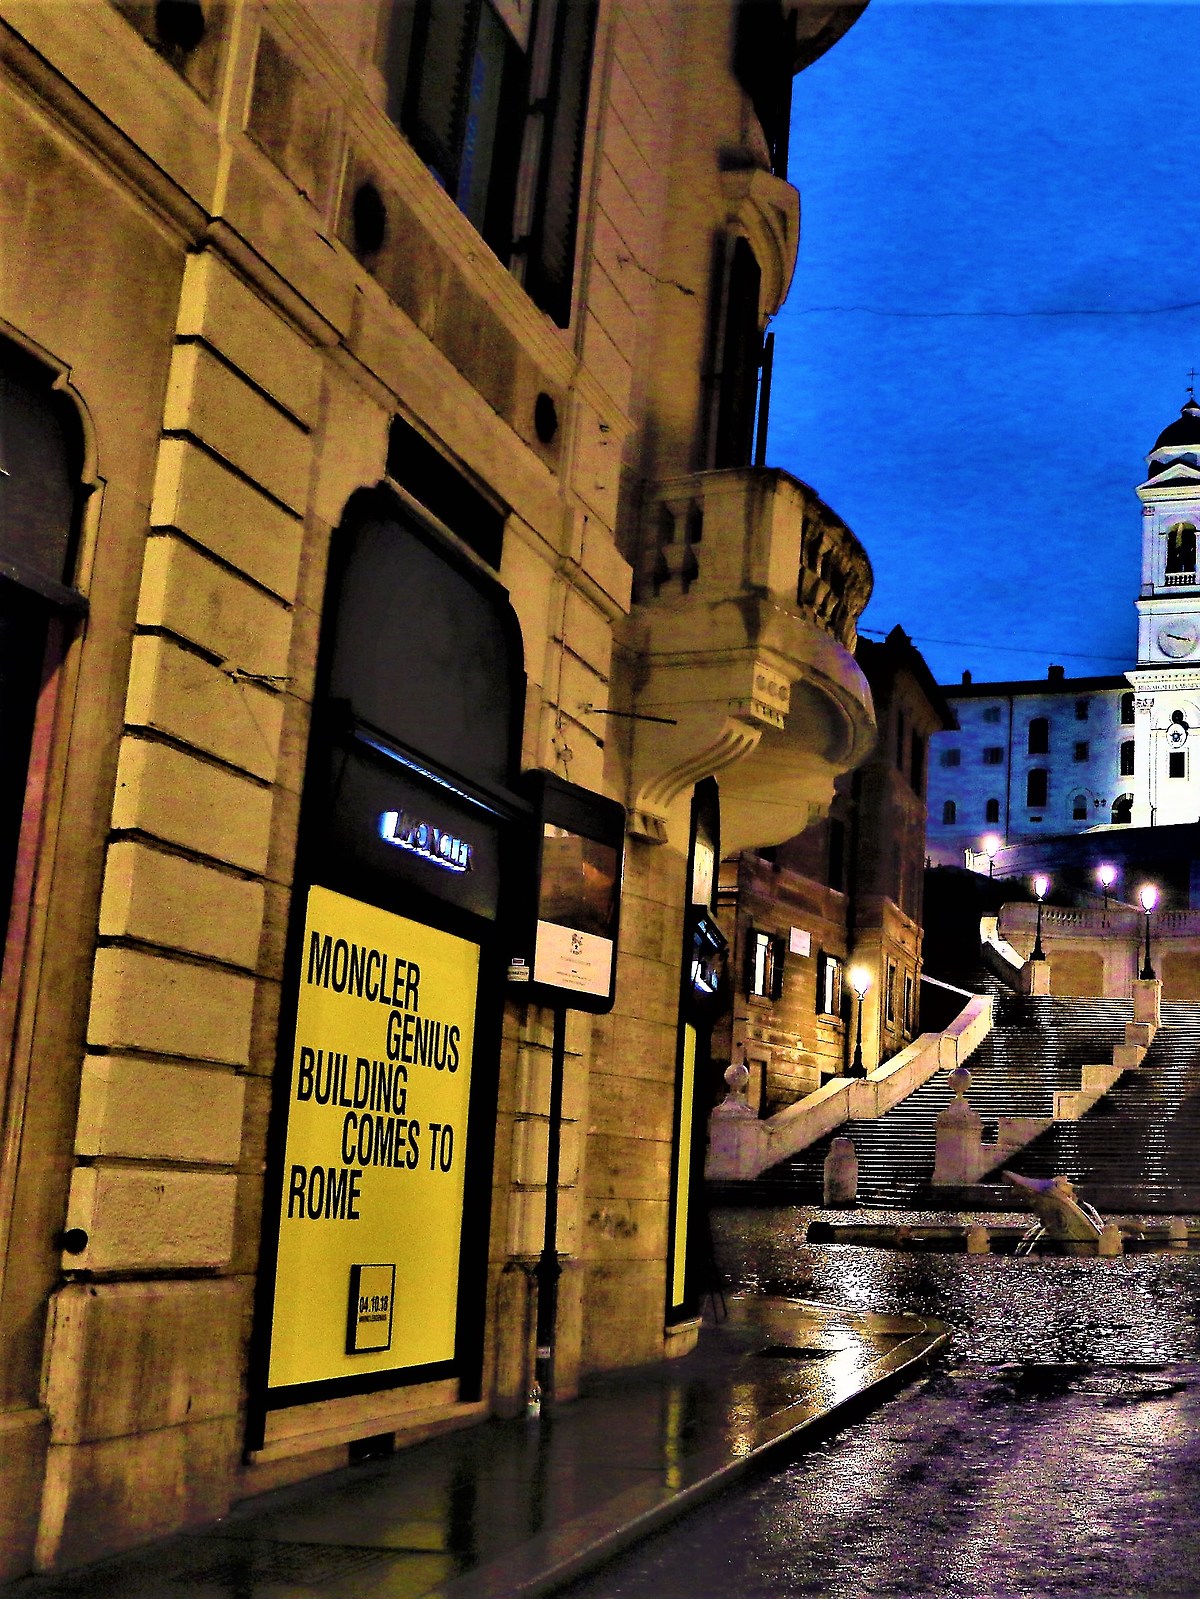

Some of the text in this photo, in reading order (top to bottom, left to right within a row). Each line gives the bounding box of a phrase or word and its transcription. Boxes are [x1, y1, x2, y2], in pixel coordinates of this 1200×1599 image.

[306, 930, 421, 1012] MONCLER
[386, 1009, 461, 1073] GENIUS
[296, 1046, 408, 1115] BUILDING
[341, 1111, 454, 1173] COMES TO
[287, 1164, 363, 1220] ROME
